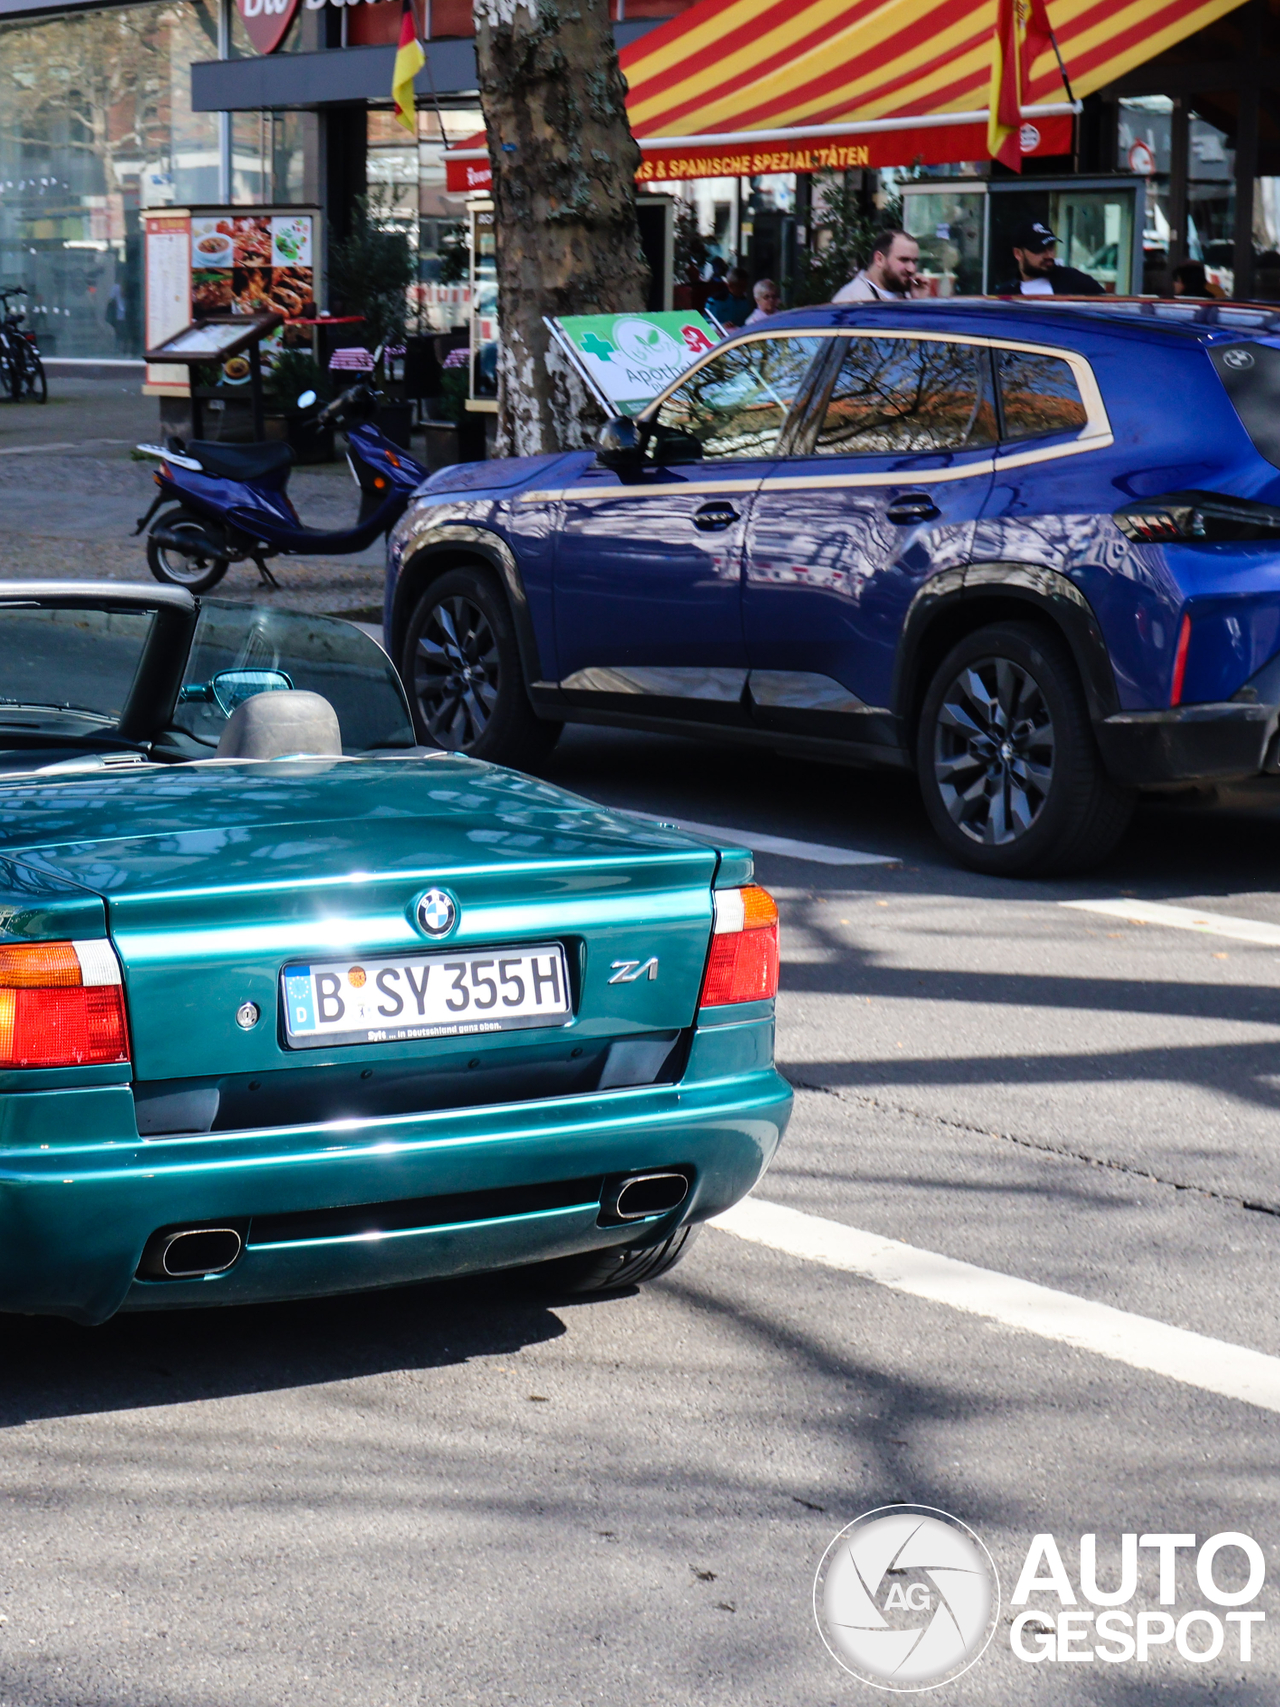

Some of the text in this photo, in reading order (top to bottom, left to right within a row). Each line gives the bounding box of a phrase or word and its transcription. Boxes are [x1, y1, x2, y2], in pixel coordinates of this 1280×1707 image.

[655, 160, 667, 178] &
[669, 156, 751, 177] SPANISCHE
[608, 956, 660, 985] Z1
[296, 955, 561, 1023] D B SY 355H
[367, 1030, 387, 1042] Sylt
[397, 1030, 406, 1039] in
[407, 1024, 458, 1038] Deutschland
[458, 1023, 479, 1034] ganz
[479, 1021, 502, 1031] oben.
